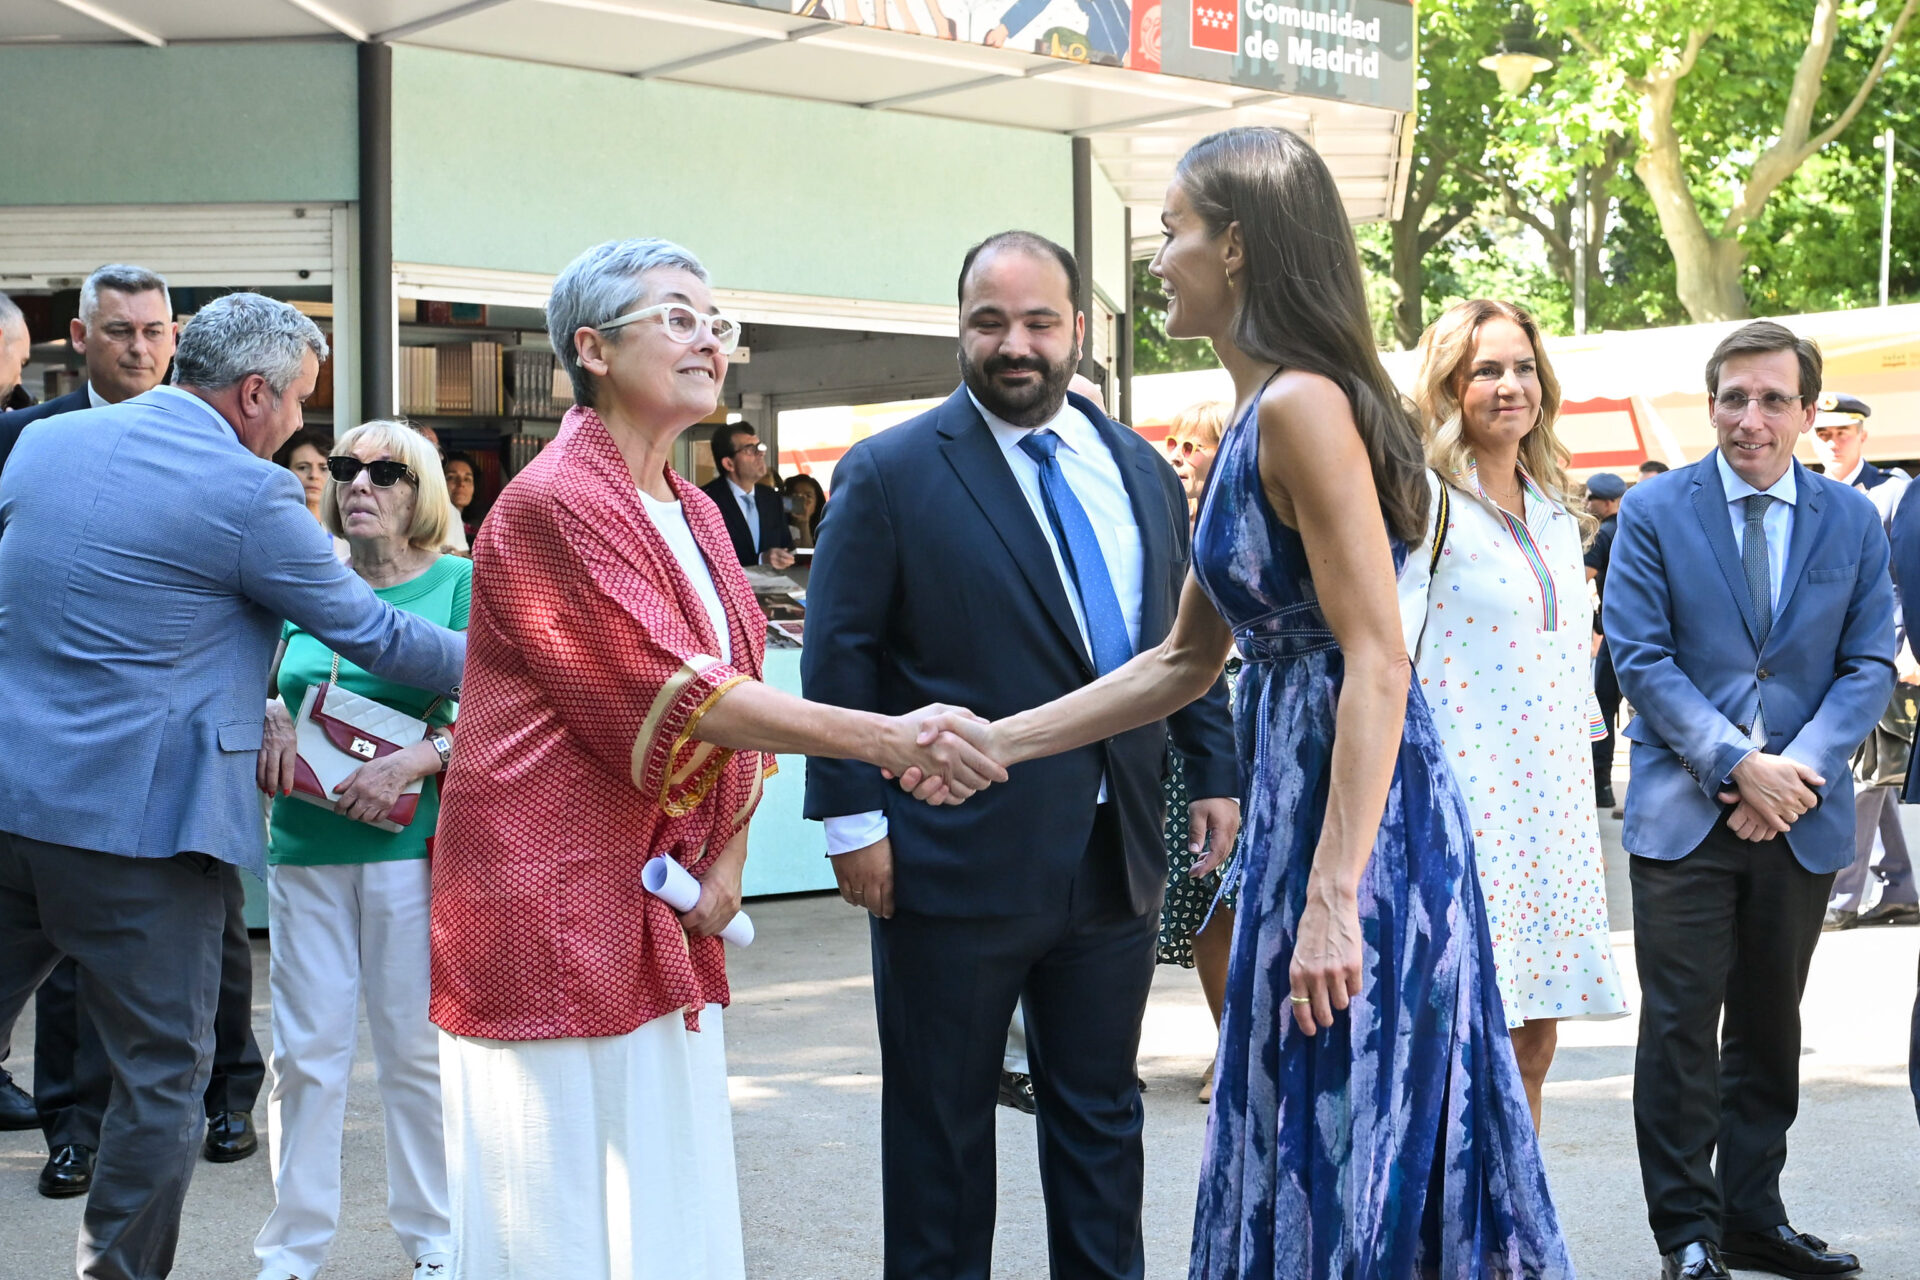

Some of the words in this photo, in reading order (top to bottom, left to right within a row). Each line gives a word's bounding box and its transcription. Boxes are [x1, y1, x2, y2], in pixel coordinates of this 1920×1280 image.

[1245, 0, 1380, 43] Comunidad
[1245, 30, 1279, 62] de
[1287, 36, 1379, 79] Madrid
